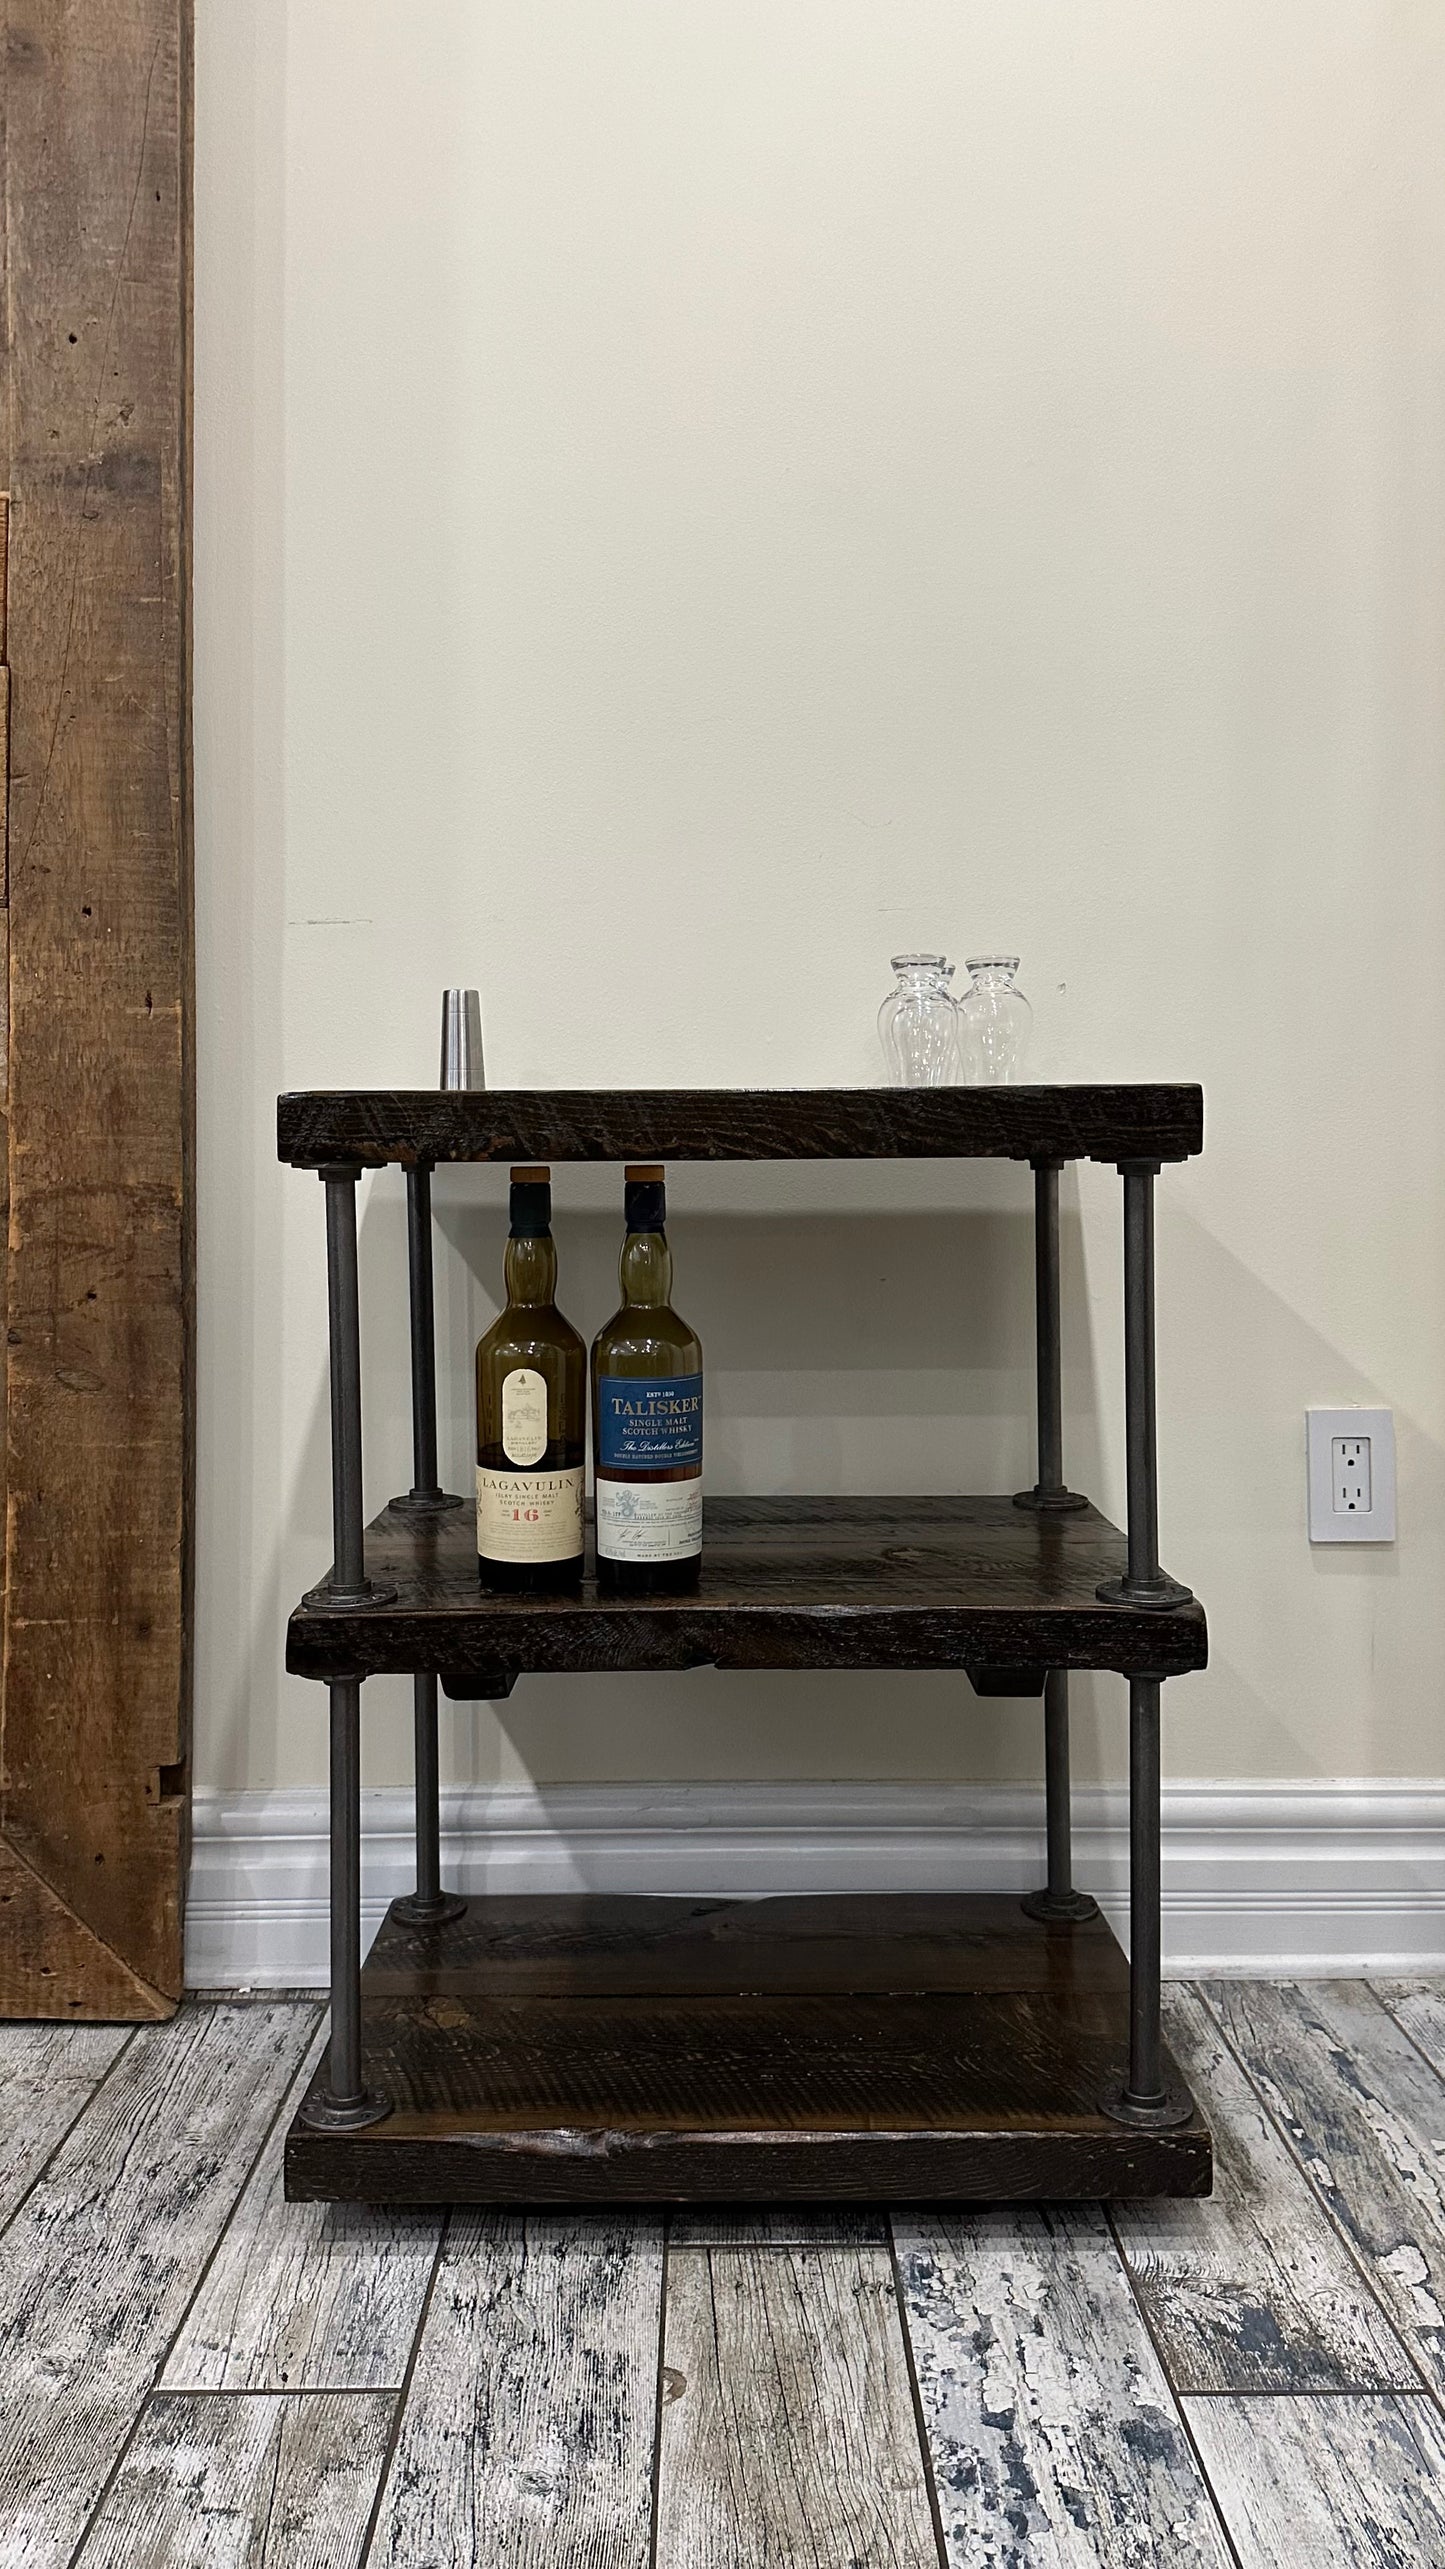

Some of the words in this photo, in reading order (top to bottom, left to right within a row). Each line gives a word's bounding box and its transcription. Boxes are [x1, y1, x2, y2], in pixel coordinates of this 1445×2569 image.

[611, 1397, 699, 1416] TALISKER
[629, 1418, 662, 1427] SINGLE
[665, 1416, 688, 1426] MALT
[622, 1427, 658, 1436] SCOTCH
[661, 1424, 692, 1435] WHISKY
[619, 1440, 637, 1451] The
[637, 1440, 673, 1452] Distillers
[482, 1477, 575, 1491] LAGAVULIN
[512, 1508, 540, 1522] 16
